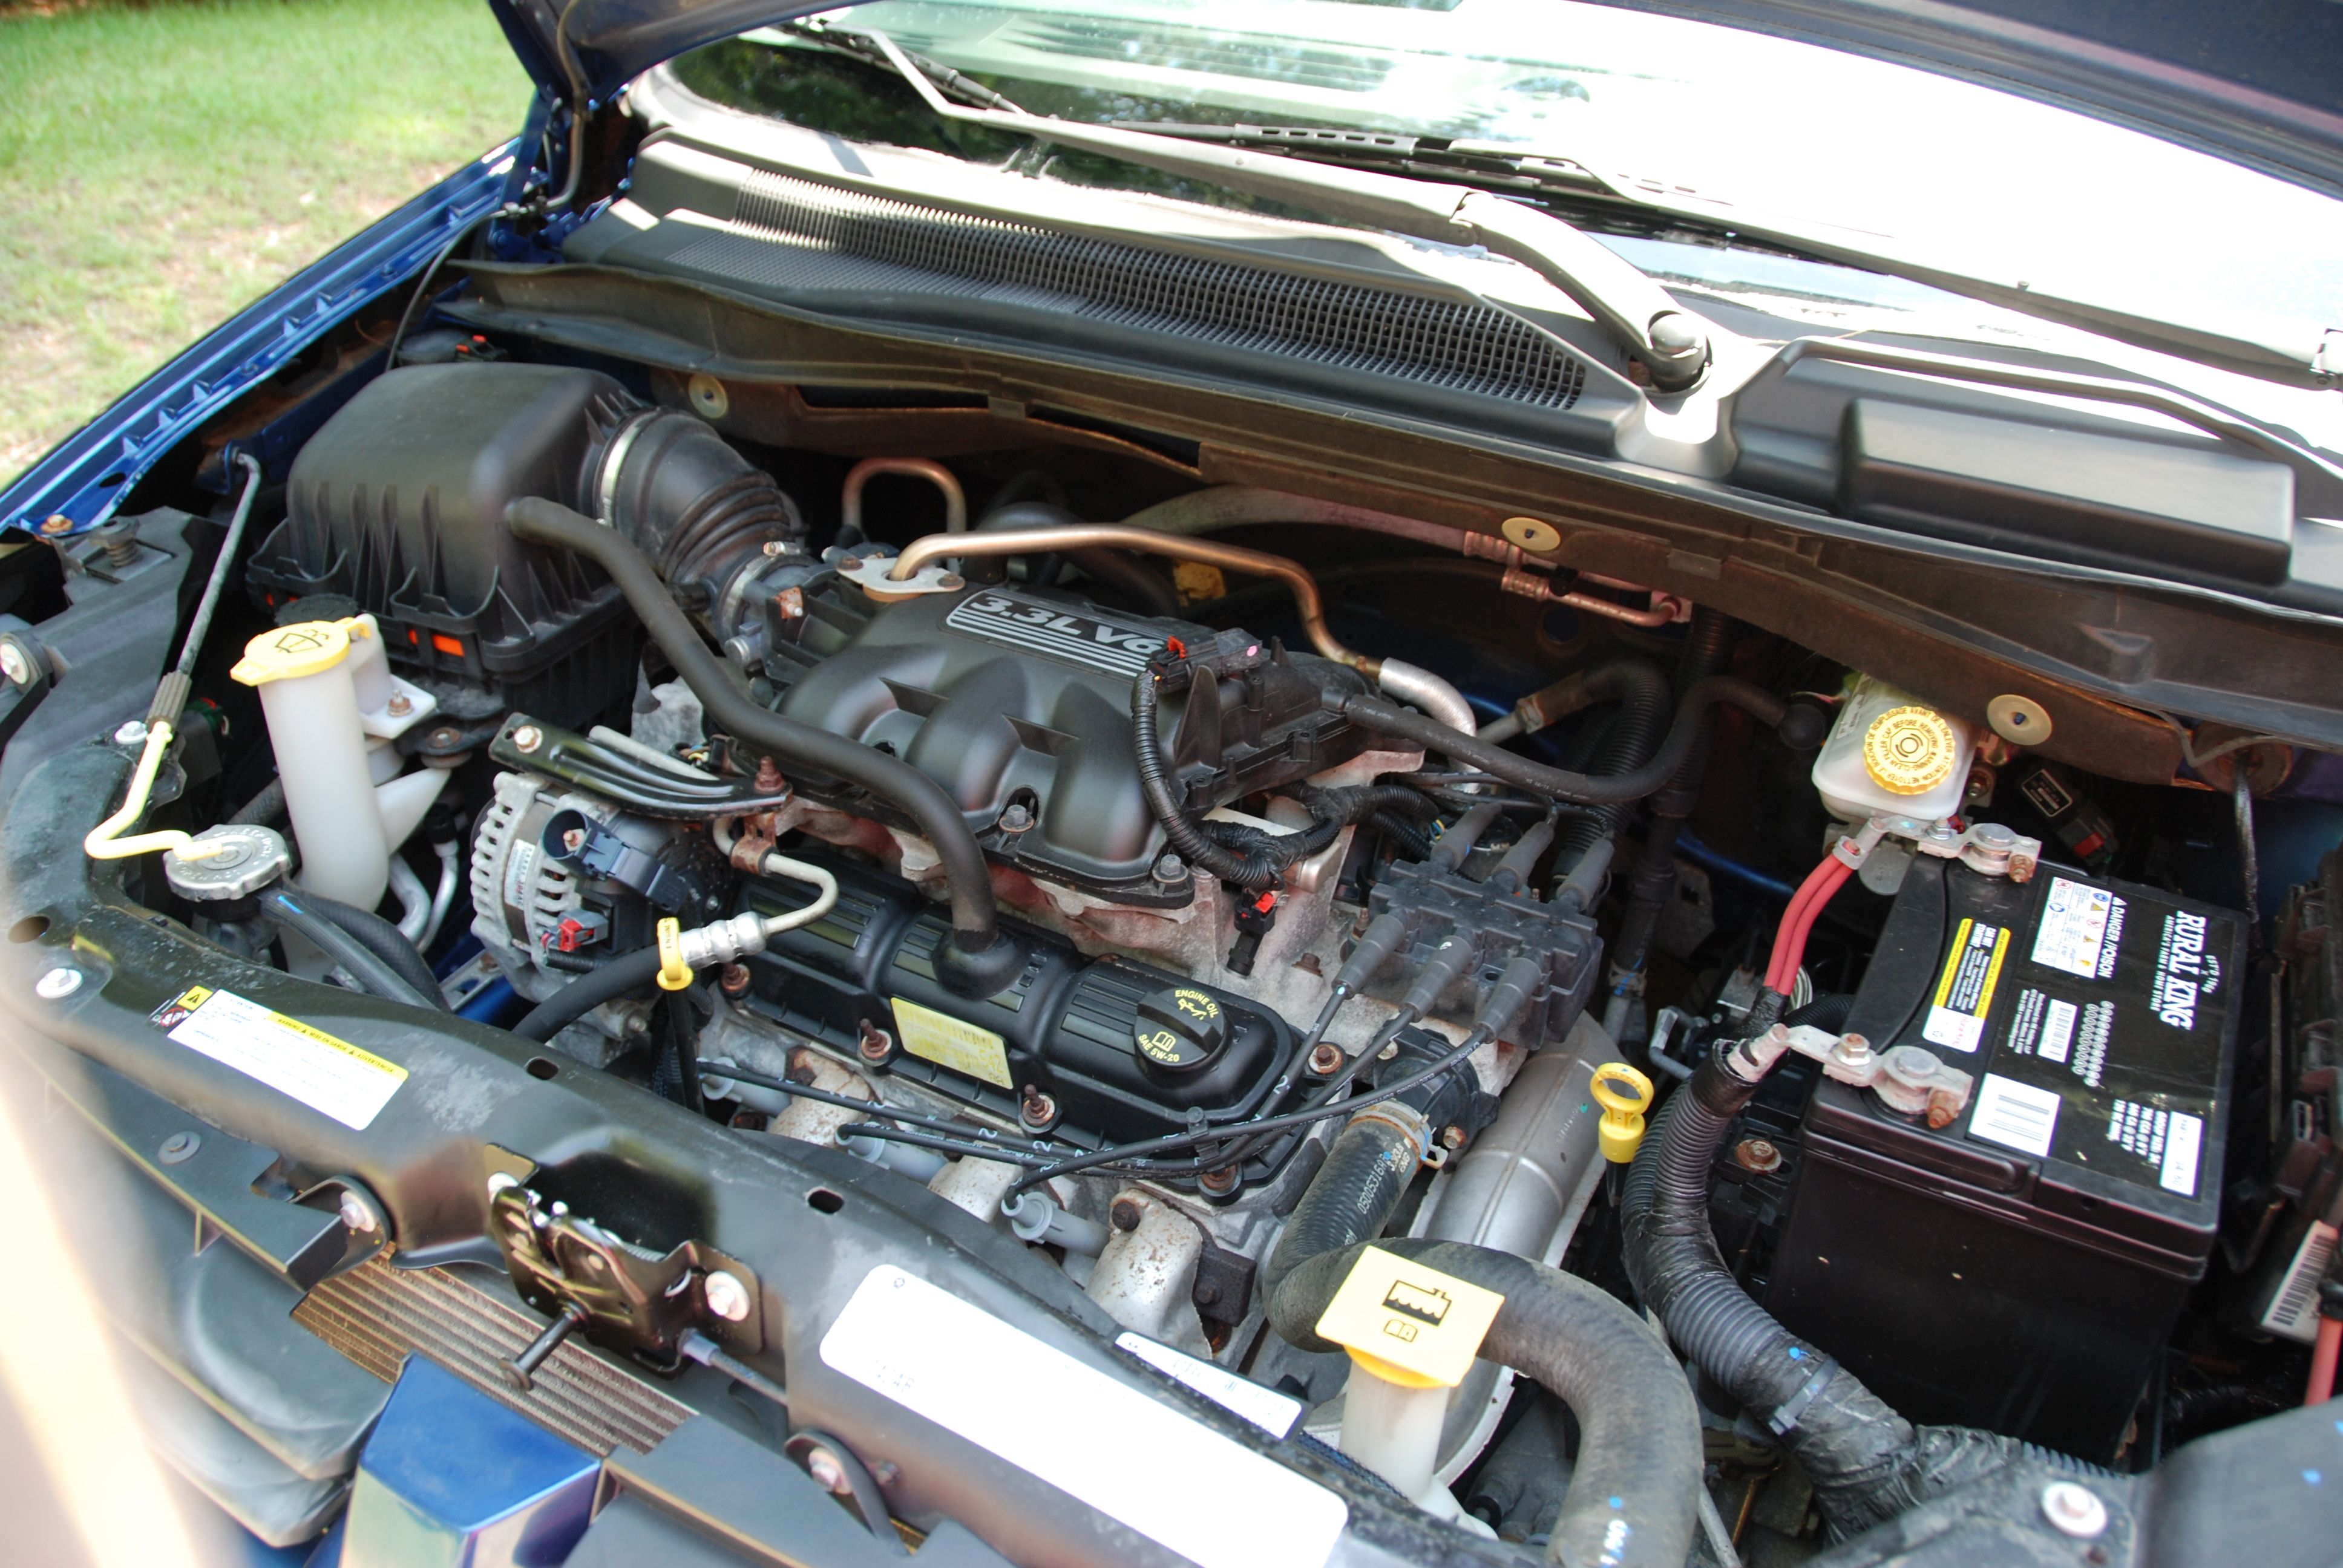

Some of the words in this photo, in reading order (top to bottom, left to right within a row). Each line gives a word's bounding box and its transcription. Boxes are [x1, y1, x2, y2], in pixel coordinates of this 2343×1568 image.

[970, 596, 1081, 635] 3.3L
[1094, 626, 1166, 654] V6
[1871, 707, 1907, 731] REMPLISSAGE
[1893, 719, 1918, 729] BEFORE
[1910, 707, 1931, 717] AVANT
[1882, 728, 1892, 738] CAP
[1919, 722, 1939, 748] REMOVING
[1866, 741, 1881, 767] BOUCHON
[1880, 741, 1890, 760] FILLER
[2105, 906, 2125, 941] DANGER
[2161, 915, 2174, 946] AMERICA'S
[2158, 947, 2170, 964] FARM
[2166, 912, 2206, 974] RURAL
[2154, 971, 2166, 990] HOME
[1175, 990, 1210, 1007] ENGINE
[1205, 1002, 1219, 1019] OIL
[2150, 990, 2164, 1011] STORE
[2159, 976, 2197, 1029] KING
[1138, 1034, 1153, 1051] SAE
[1150, 1048, 1180, 1062] 5W-20
[355, 1053, 395, 1073] ADVERTENCIA
